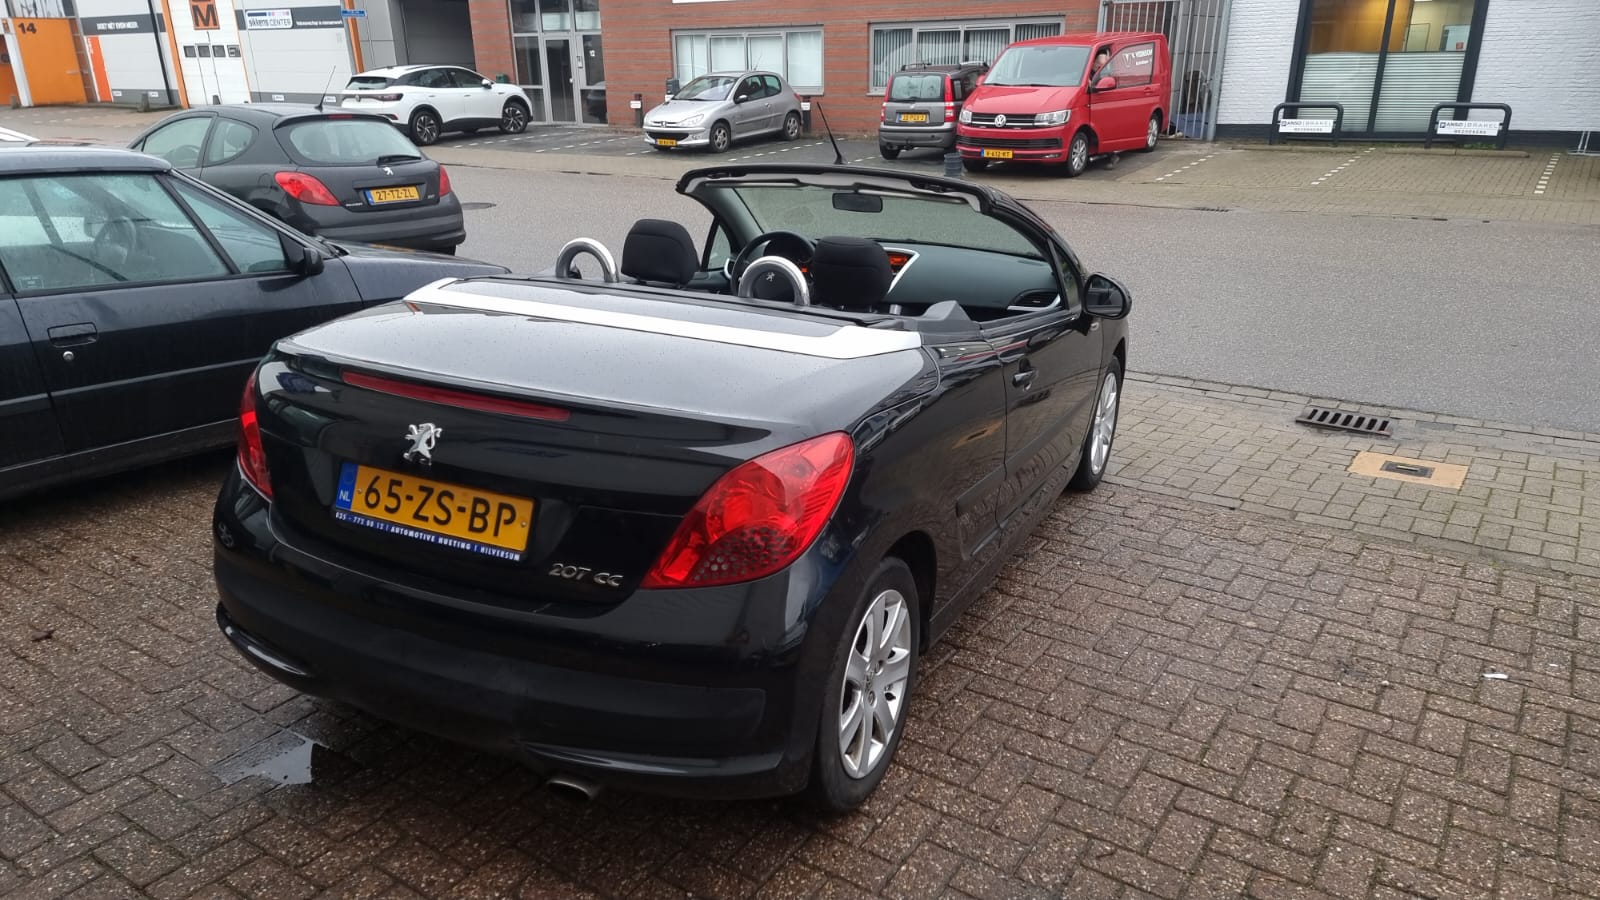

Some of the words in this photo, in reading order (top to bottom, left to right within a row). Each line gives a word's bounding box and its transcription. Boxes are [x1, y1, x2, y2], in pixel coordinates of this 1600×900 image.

[18, 22, 37, 34] 14
[375, 188, 415, 200] 27-TZ-ZL
[339, 490, 350, 502] NL
[364, 475, 517, 537] 65-ZS-BP
[390, 526, 435, 543] AUTOMOTIVE
[480, 546, 520, 562] HILVERSUM
[548, 563, 592, 580] 207
[593, 572, 624, 587] CC
